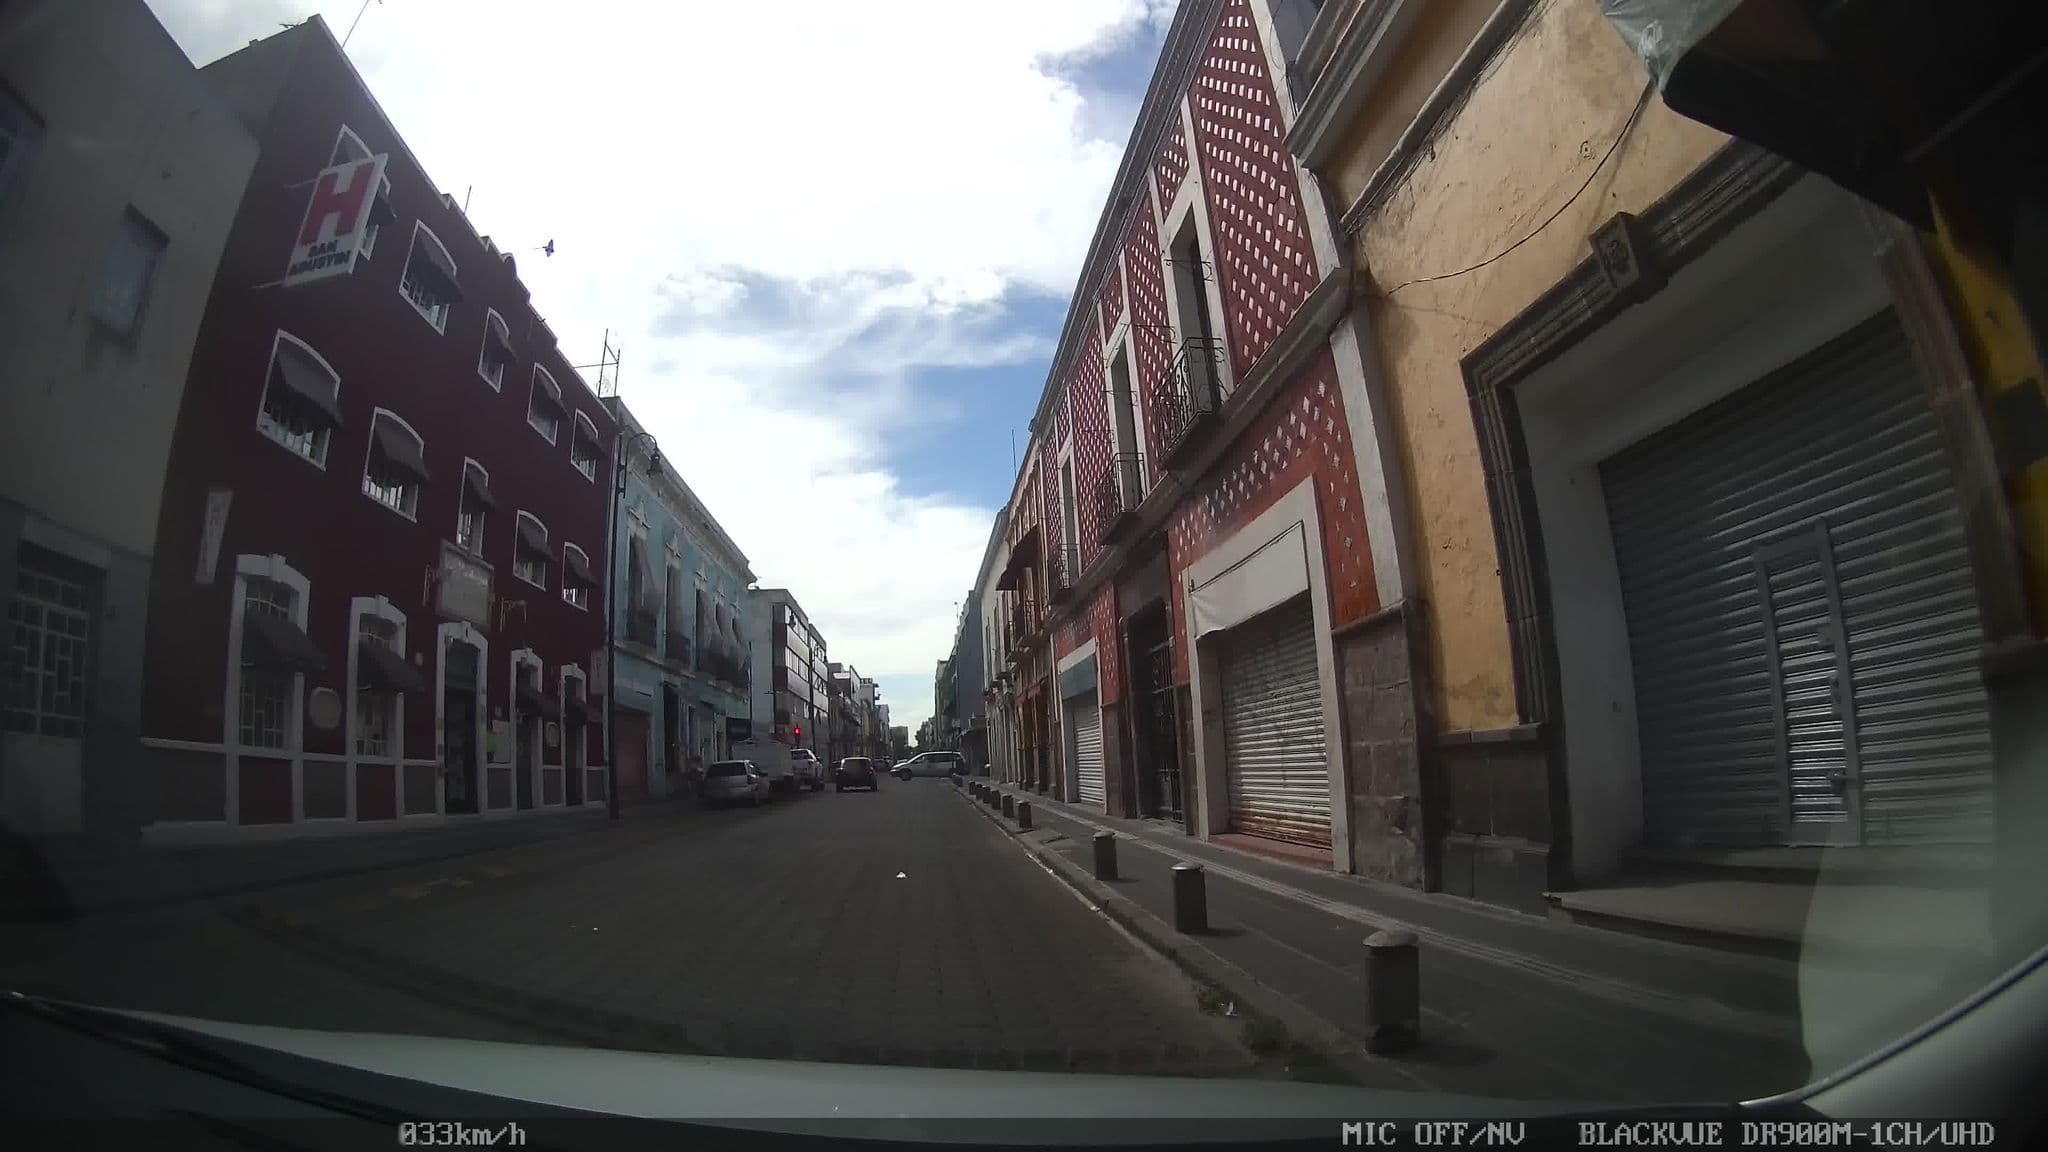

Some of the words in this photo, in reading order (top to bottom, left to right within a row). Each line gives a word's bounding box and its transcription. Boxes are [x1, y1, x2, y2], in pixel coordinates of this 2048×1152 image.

[299, 162, 375, 247] H
[307, 240, 338, 258] SAN
[288, 250, 351, 276] AGUSTIN
